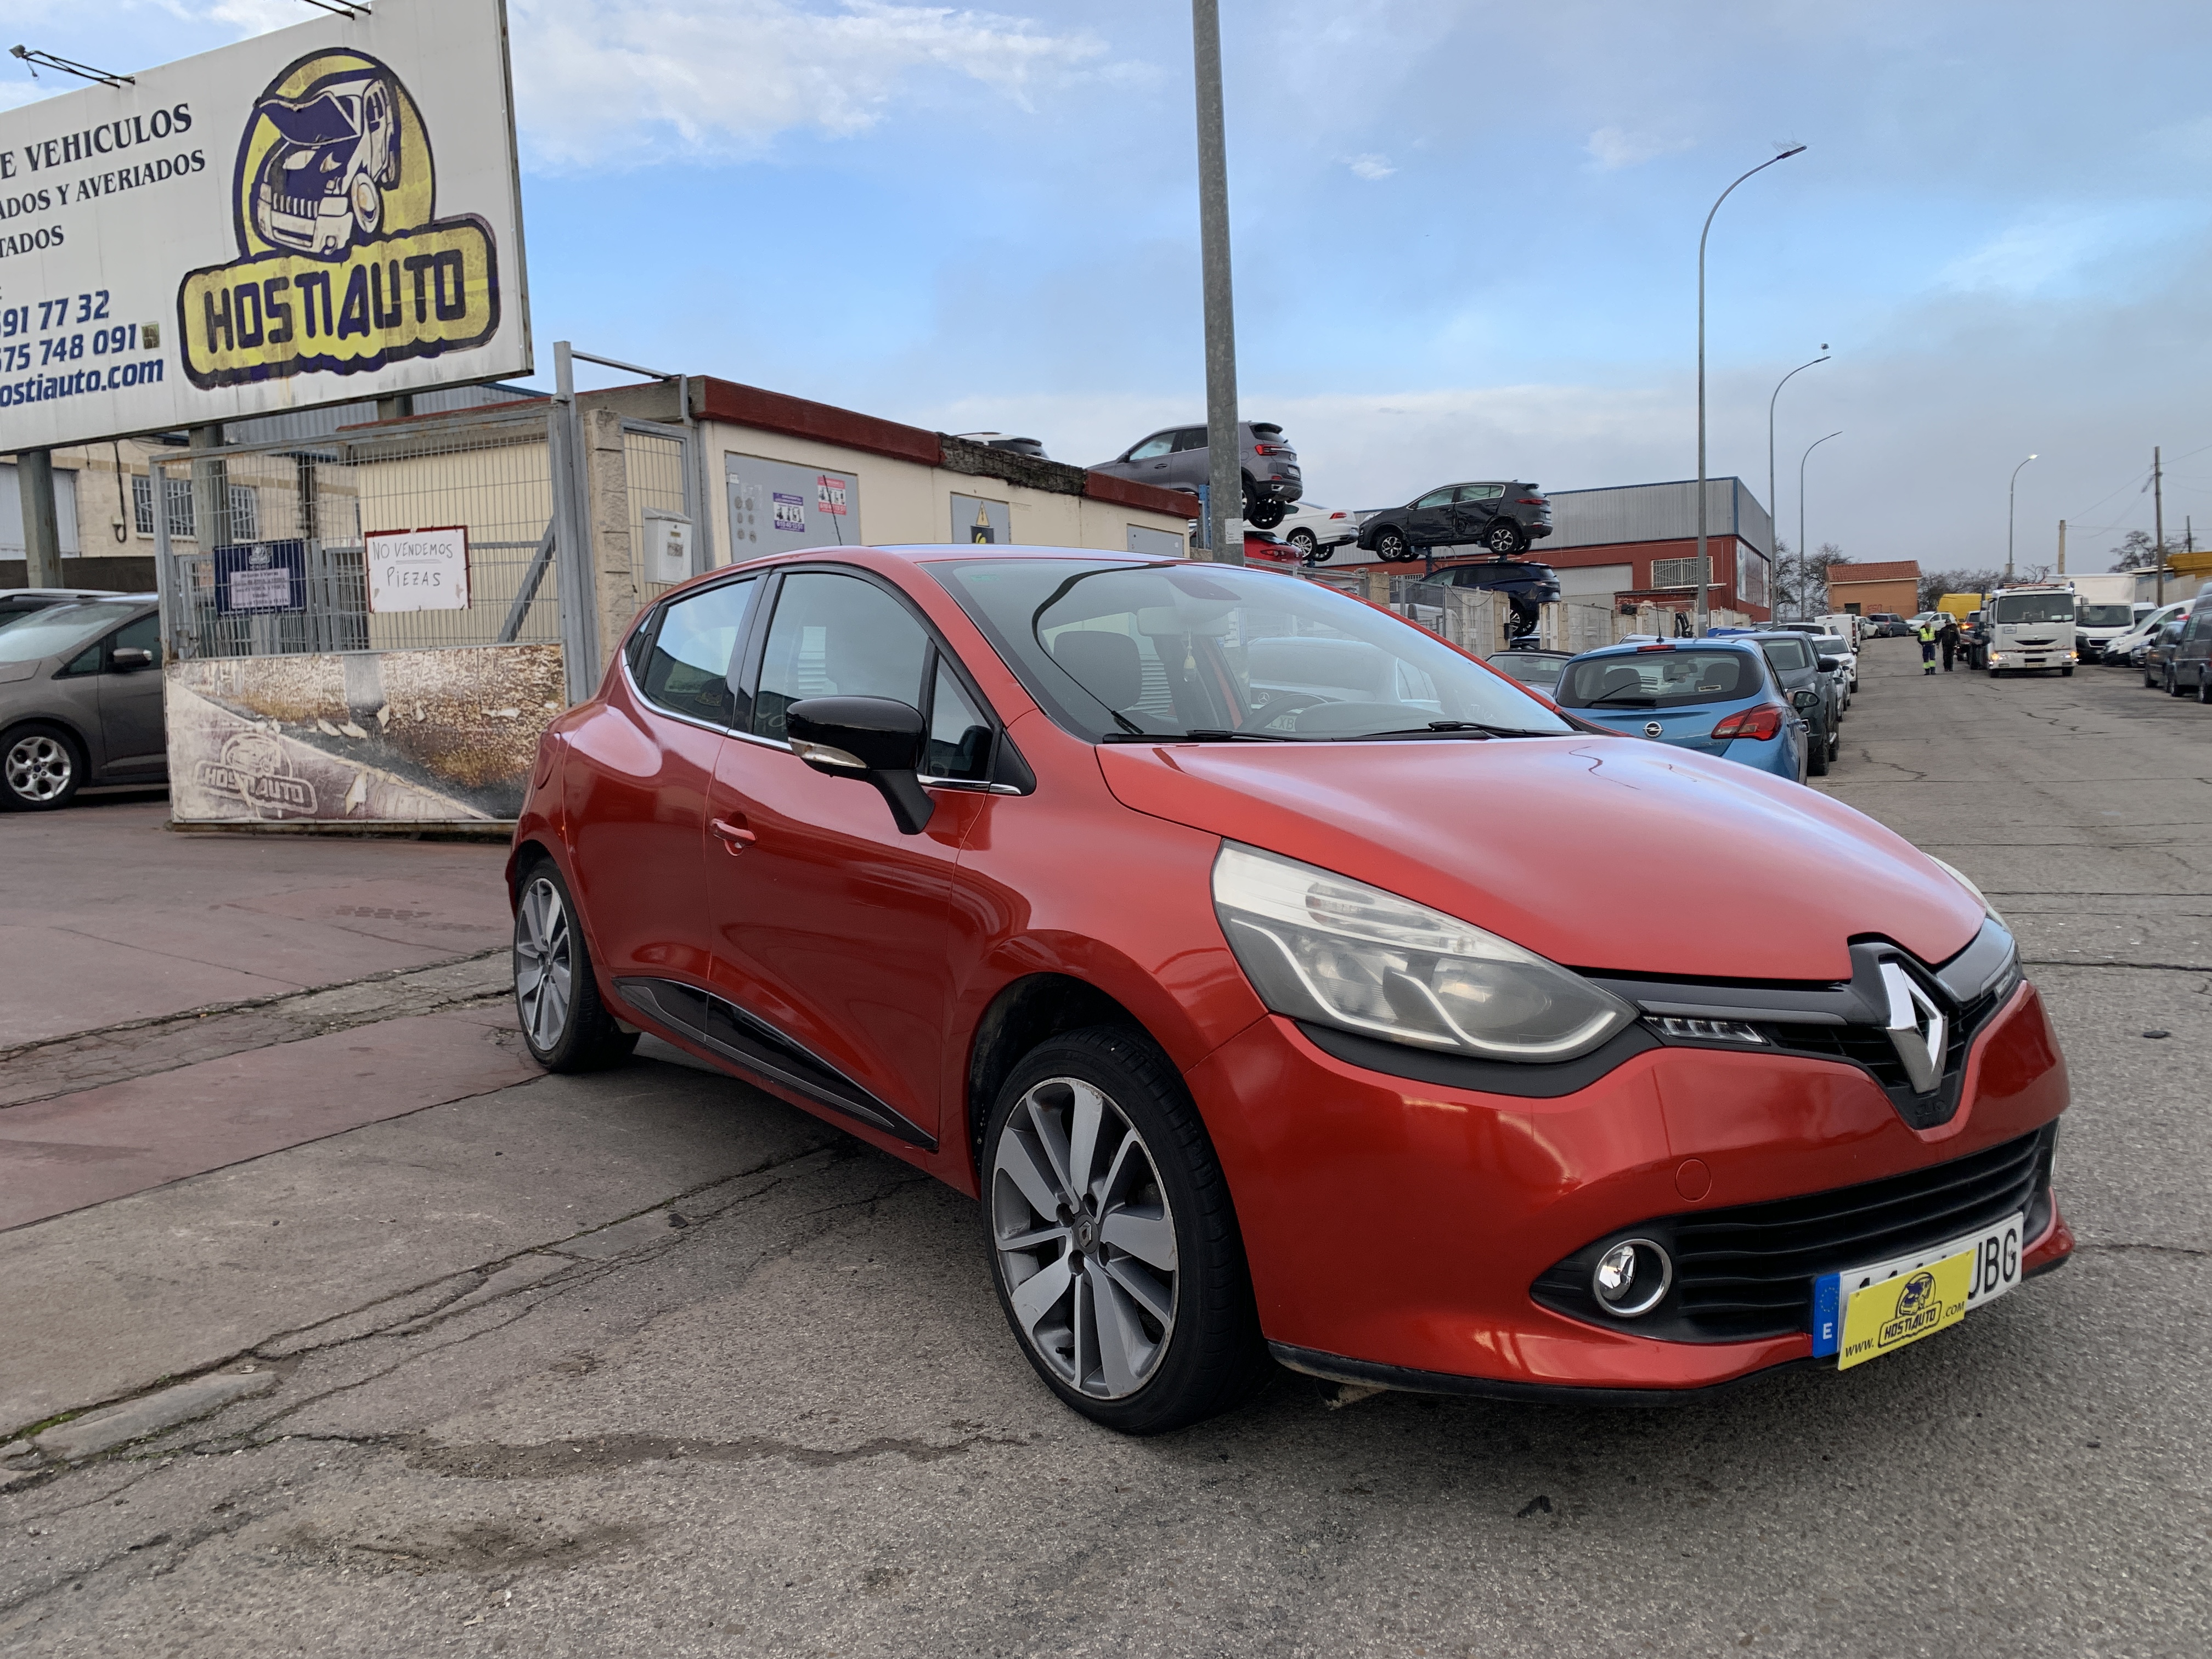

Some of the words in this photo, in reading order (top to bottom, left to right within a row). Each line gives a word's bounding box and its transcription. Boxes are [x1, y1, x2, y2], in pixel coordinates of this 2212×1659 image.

[24, 103, 192, 172] VEHICULOS
[55, 183, 70, 206] Y
[76, 149, 206, 202] AVERIADOS
[0, 305, 29, 338] 91
[38, 297, 69, 330] 77
[76, 289, 109, 324] 32
[204, 249, 466, 354] HOSTIAUTO
[0, 342, 30, 373] 75
[39, 334, 83, 366] 748
[93, 323, 137, 356] 091
[373, 541, 390, 561] NO
[394, 541, 453, 559] VENDEMOS
[1823, 1322, 1833, 1340] E
[1884, 1307, 1937, 1340] HOSTIAUTO
[1943, 1301, 1965, 1319] .COM
